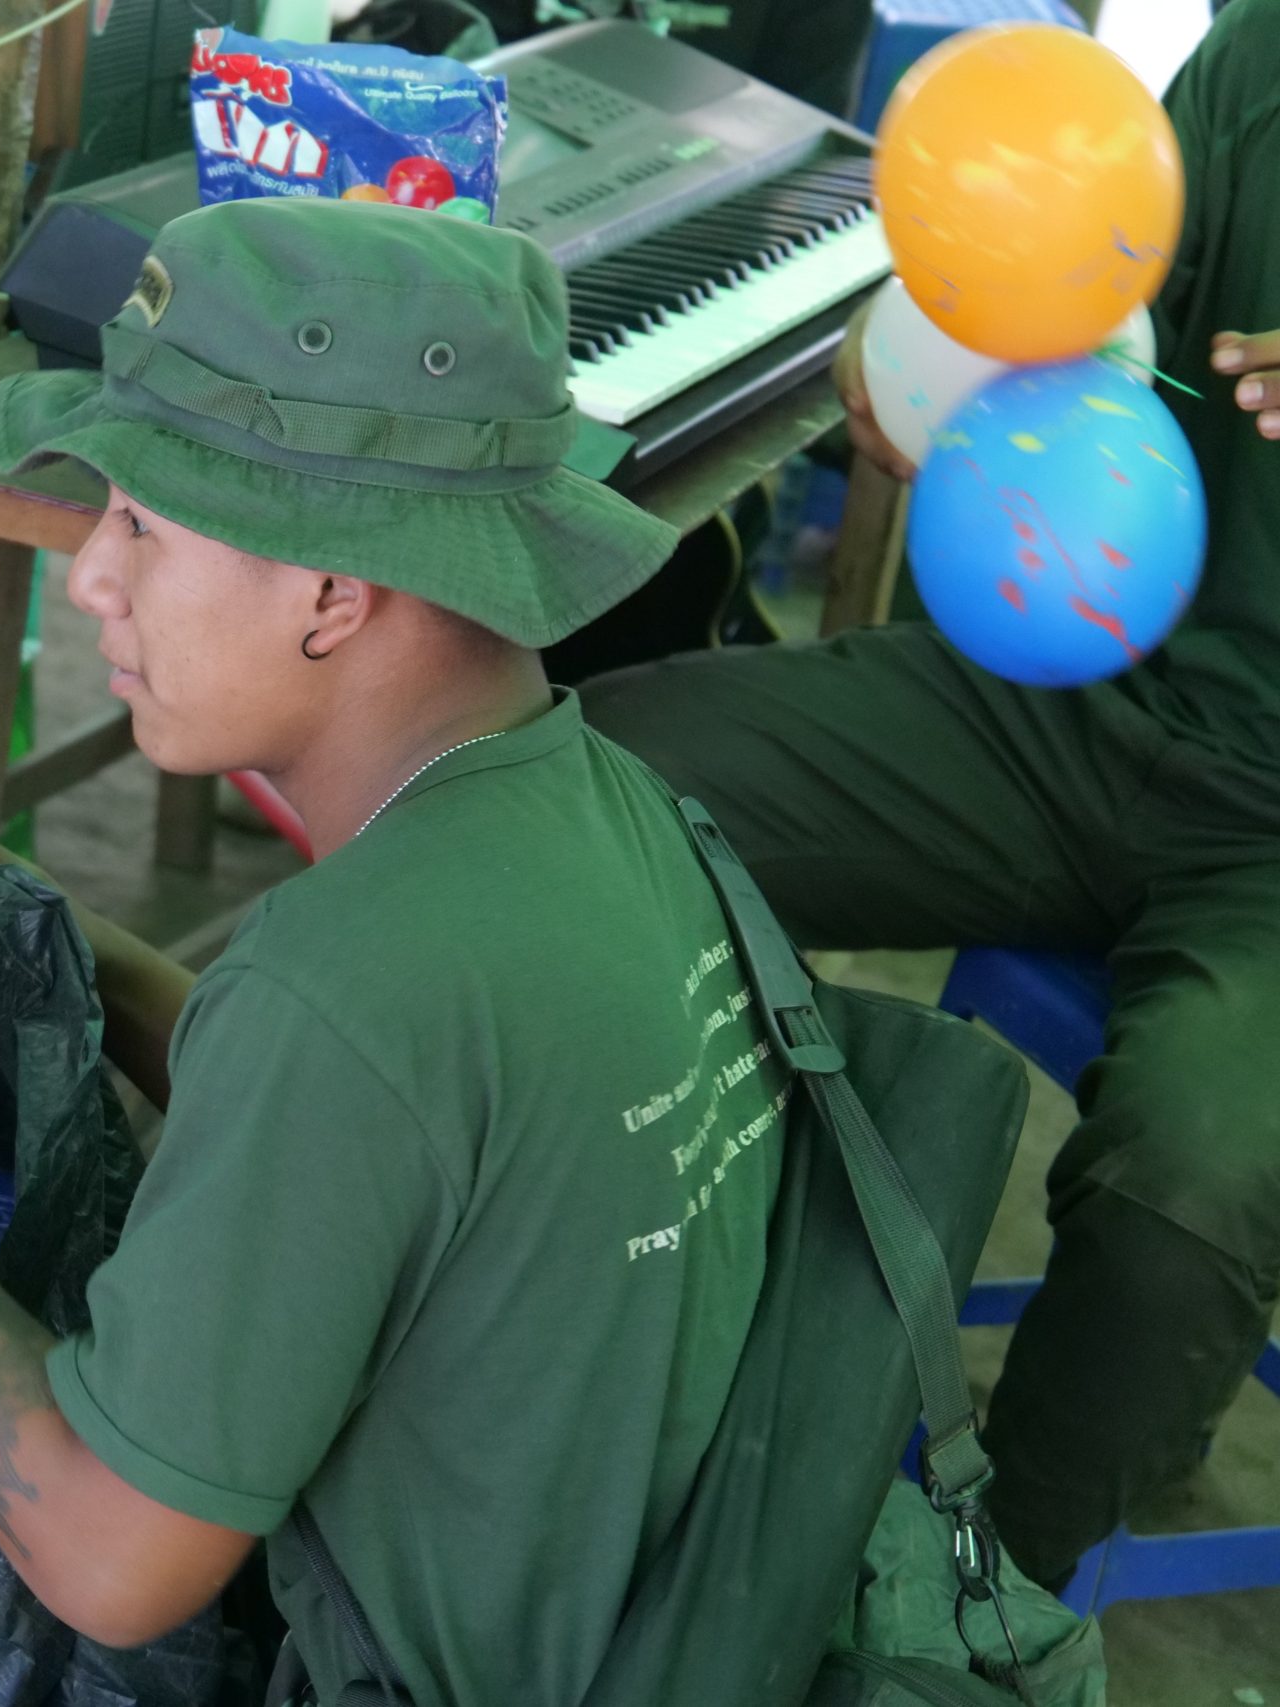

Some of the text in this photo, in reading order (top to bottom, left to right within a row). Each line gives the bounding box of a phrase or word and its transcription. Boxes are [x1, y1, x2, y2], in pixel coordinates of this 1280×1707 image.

[722, 1053, 757, 1089] hate
[621, 1093, 676, 1133] Unite
[625, 1223, 682, 1262] Pray
